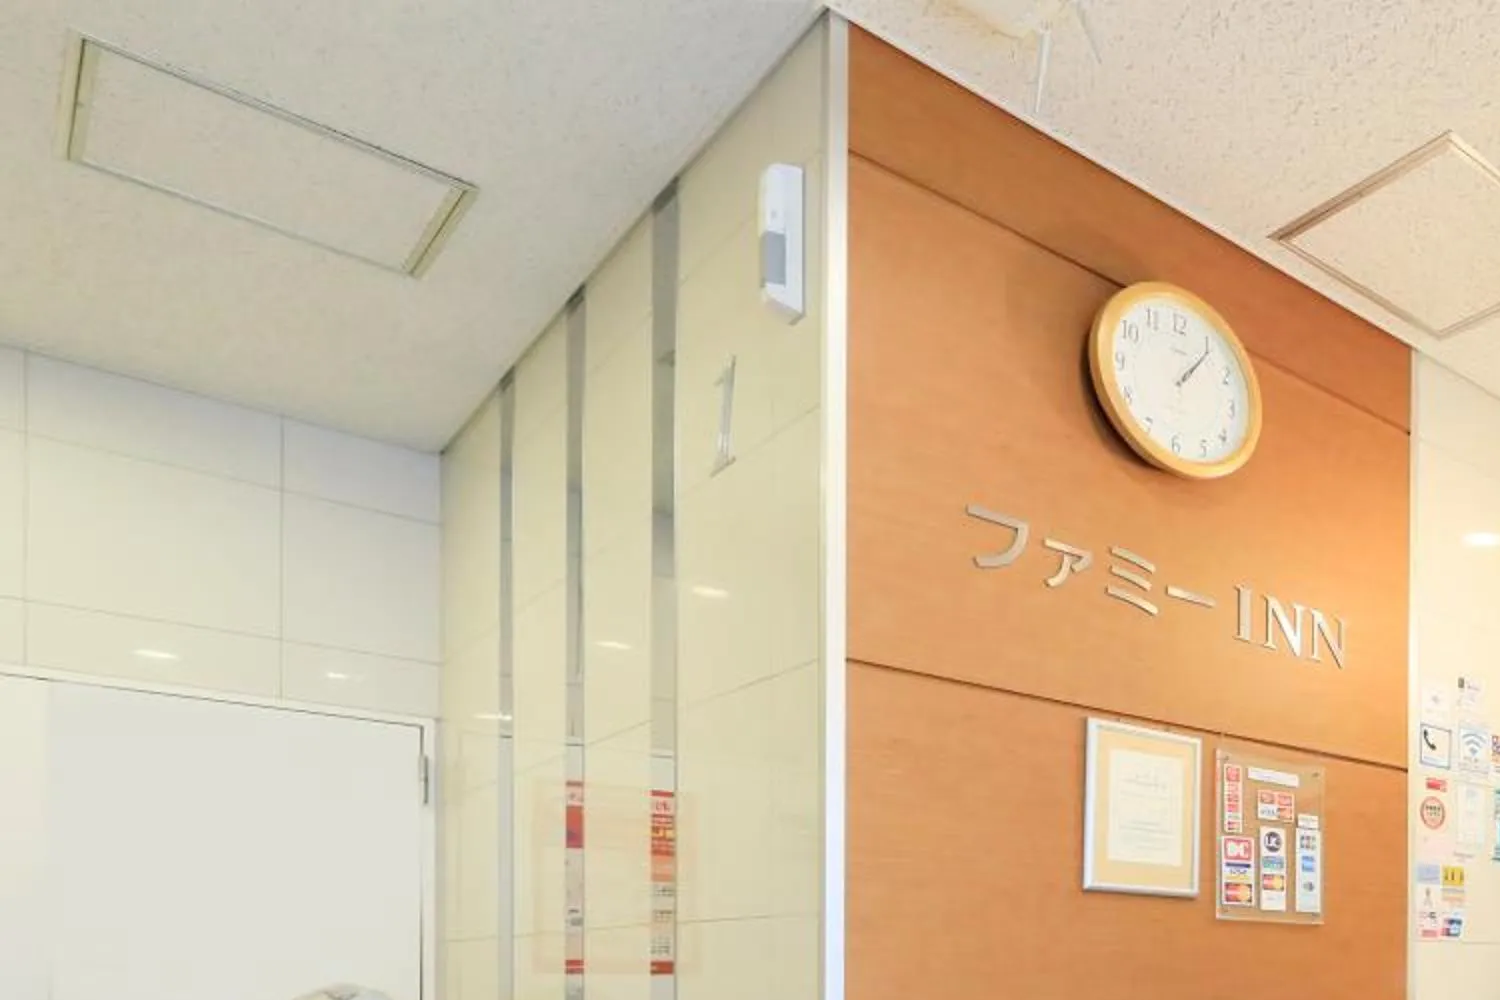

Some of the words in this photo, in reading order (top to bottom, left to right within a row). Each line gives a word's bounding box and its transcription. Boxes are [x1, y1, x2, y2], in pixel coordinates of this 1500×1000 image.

[1120, 319, 1139, 344] 10
[1145, 307, 1160, 332] 11
[1172, 312, 1188, 337] 12
[1115, 351, 1126, 371] 9
[1170, 432, 1182, 456] 6
[1199, 438, 1209, 459] 5
